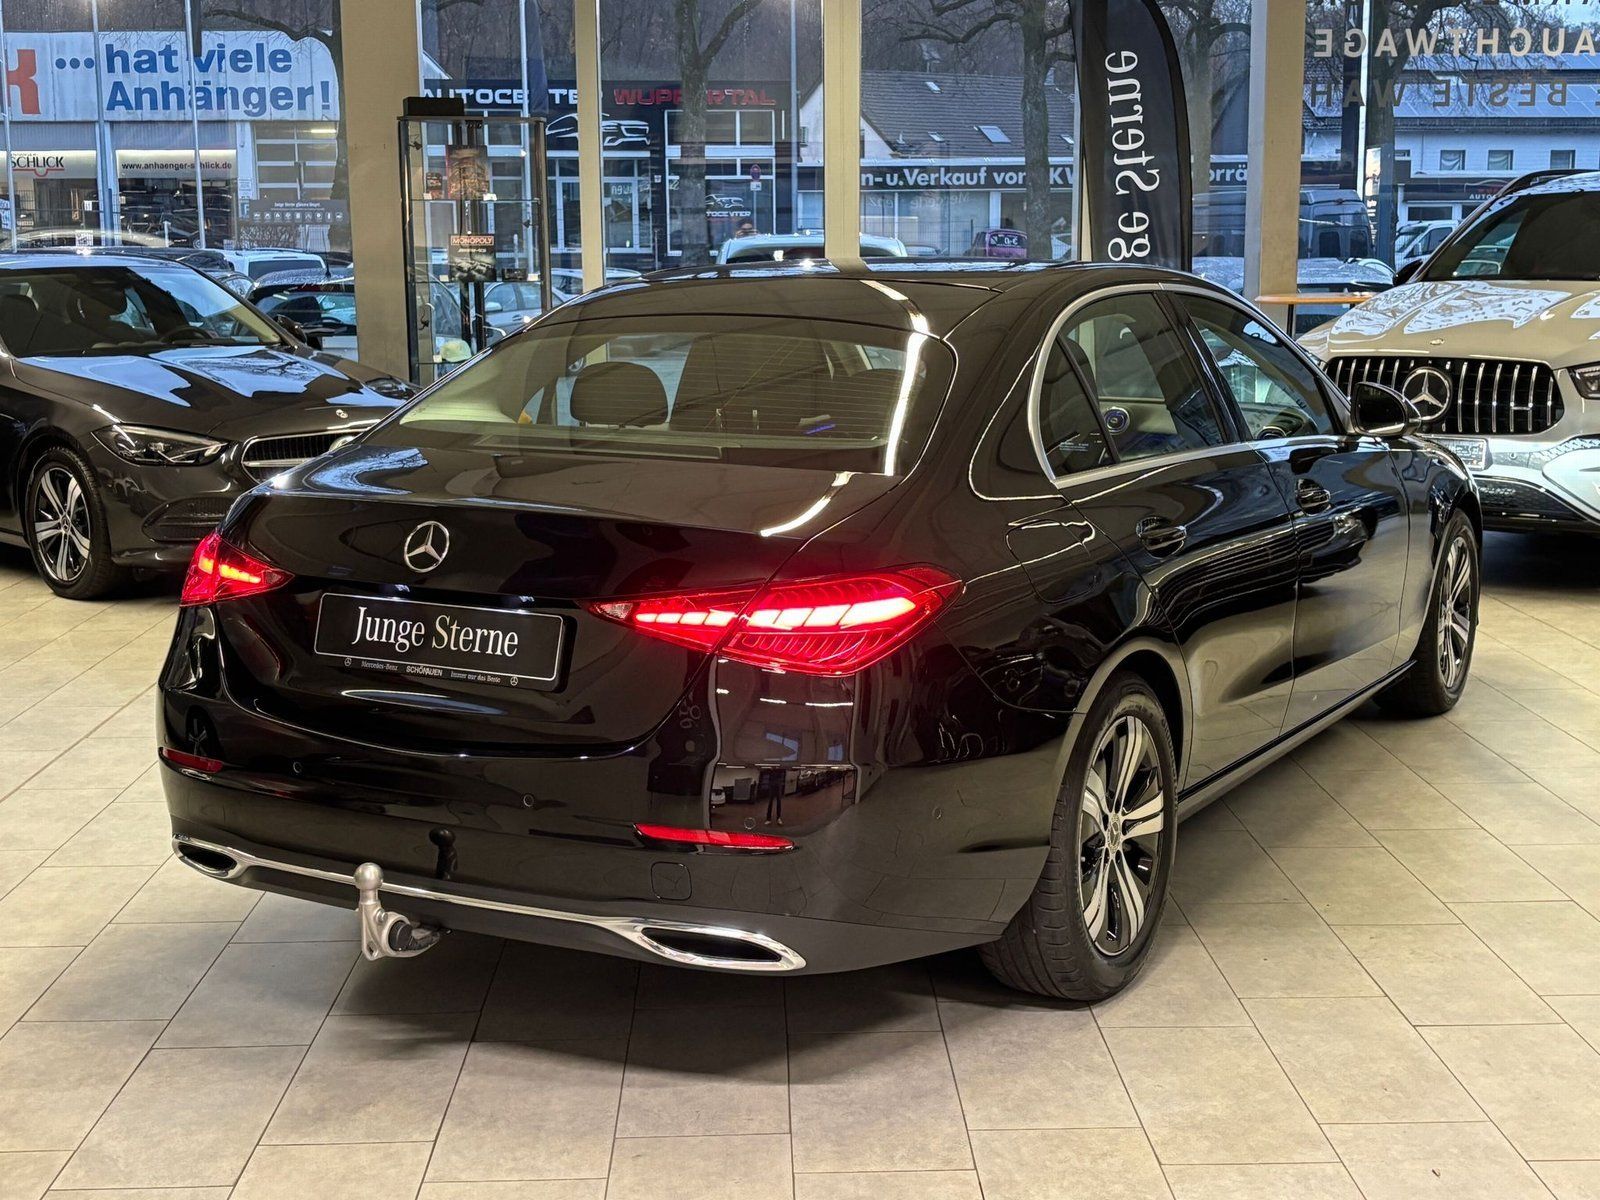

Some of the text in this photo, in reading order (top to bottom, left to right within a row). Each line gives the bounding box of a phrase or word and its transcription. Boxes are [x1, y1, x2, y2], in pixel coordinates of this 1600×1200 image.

[106, 43, 179, 73] hat
[194, 43, 292, 73] viele
[105, 80, 331, 117] Anhänger!
[11, 156, 65, 168] SCHLICK
[121, 161, 233, 171] www.anhaenger-shlick.de
[451, 236, 493, 245] MONOPOLY
[352, 606, 519, 657] Junge Sterne
